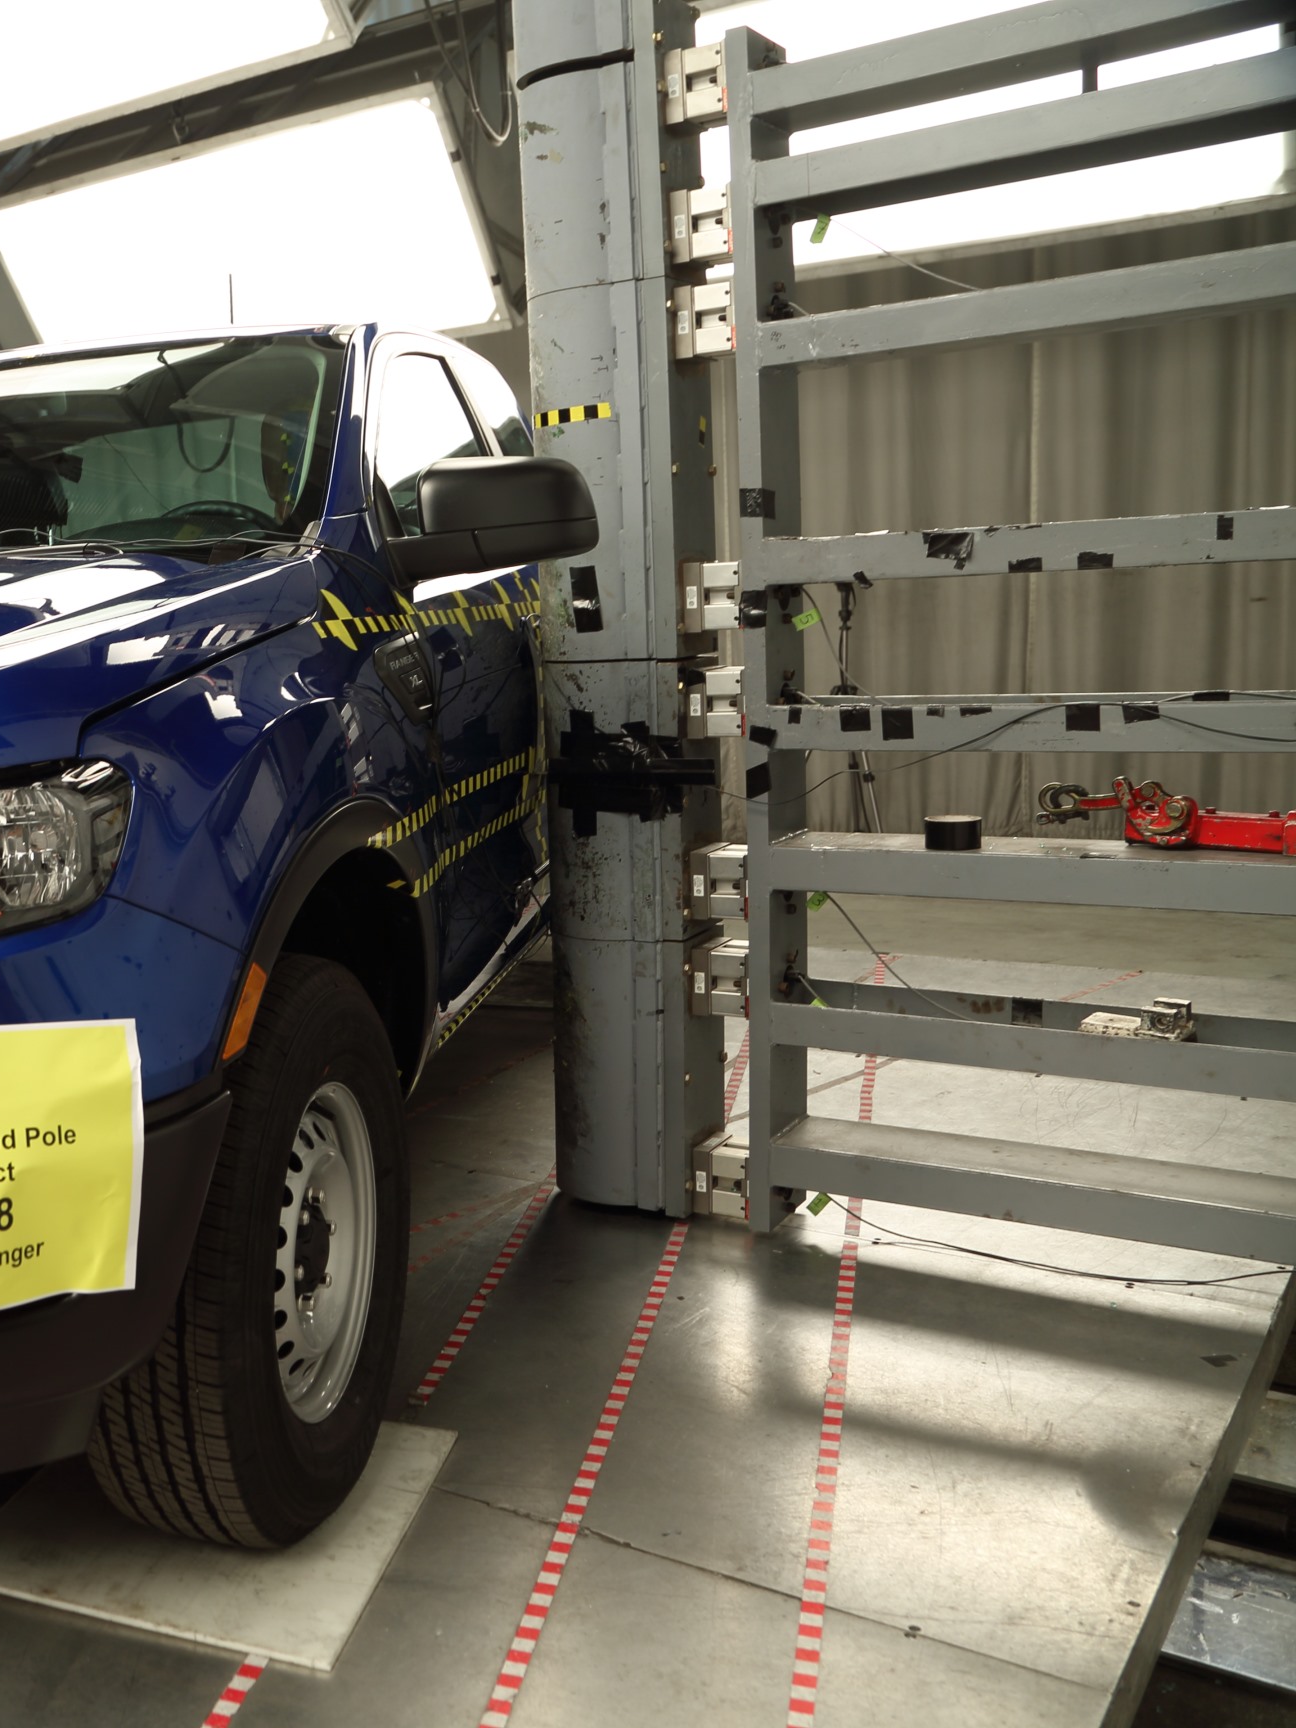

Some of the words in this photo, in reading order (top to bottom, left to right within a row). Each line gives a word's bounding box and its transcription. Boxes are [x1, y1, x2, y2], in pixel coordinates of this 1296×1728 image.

[799, 613, 814, 625] 5
[409, 674, 423, 688] XL
[25, 1125, 76, 1148] Pole
